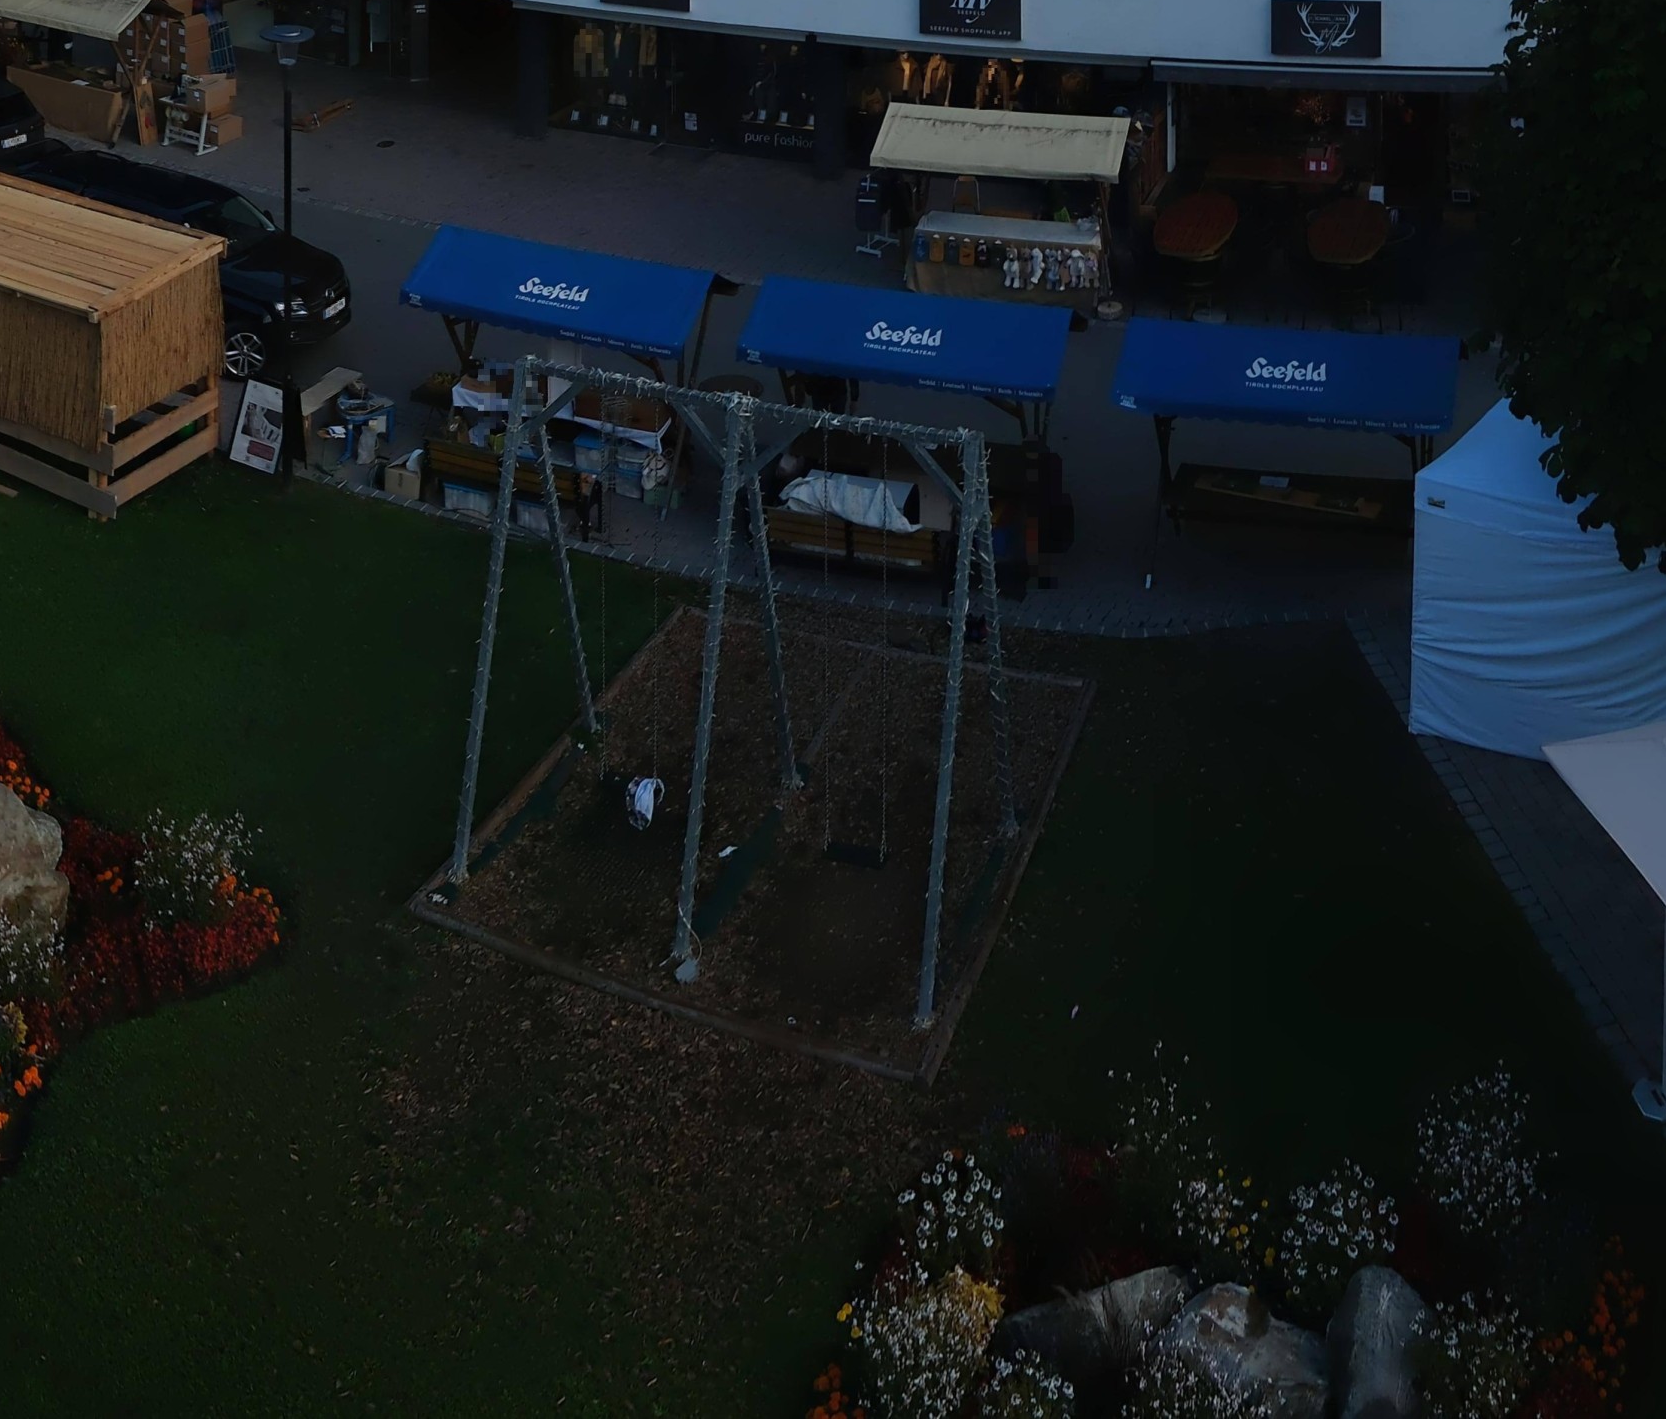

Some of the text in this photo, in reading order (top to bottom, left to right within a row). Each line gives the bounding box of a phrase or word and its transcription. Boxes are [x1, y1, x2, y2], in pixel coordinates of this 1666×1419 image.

[929, 25, 959, 33] SEEFELD
[961, 27, 996, 35] SHOPPING
[744, 133, 770, 144] pure
[519, 277, 589, 302] Seefeld
[515, 294, 580, 310] TIROLS HOCHPLATEAU
[865, 321, 942, 347] Seefeld
[863, 342, 937, 356] TIROLS HOCHPLATEAU
[1246, 357, 1326, 382] Seefeld
[1272, 383, 1323, 392] HOCHPLATEAU
